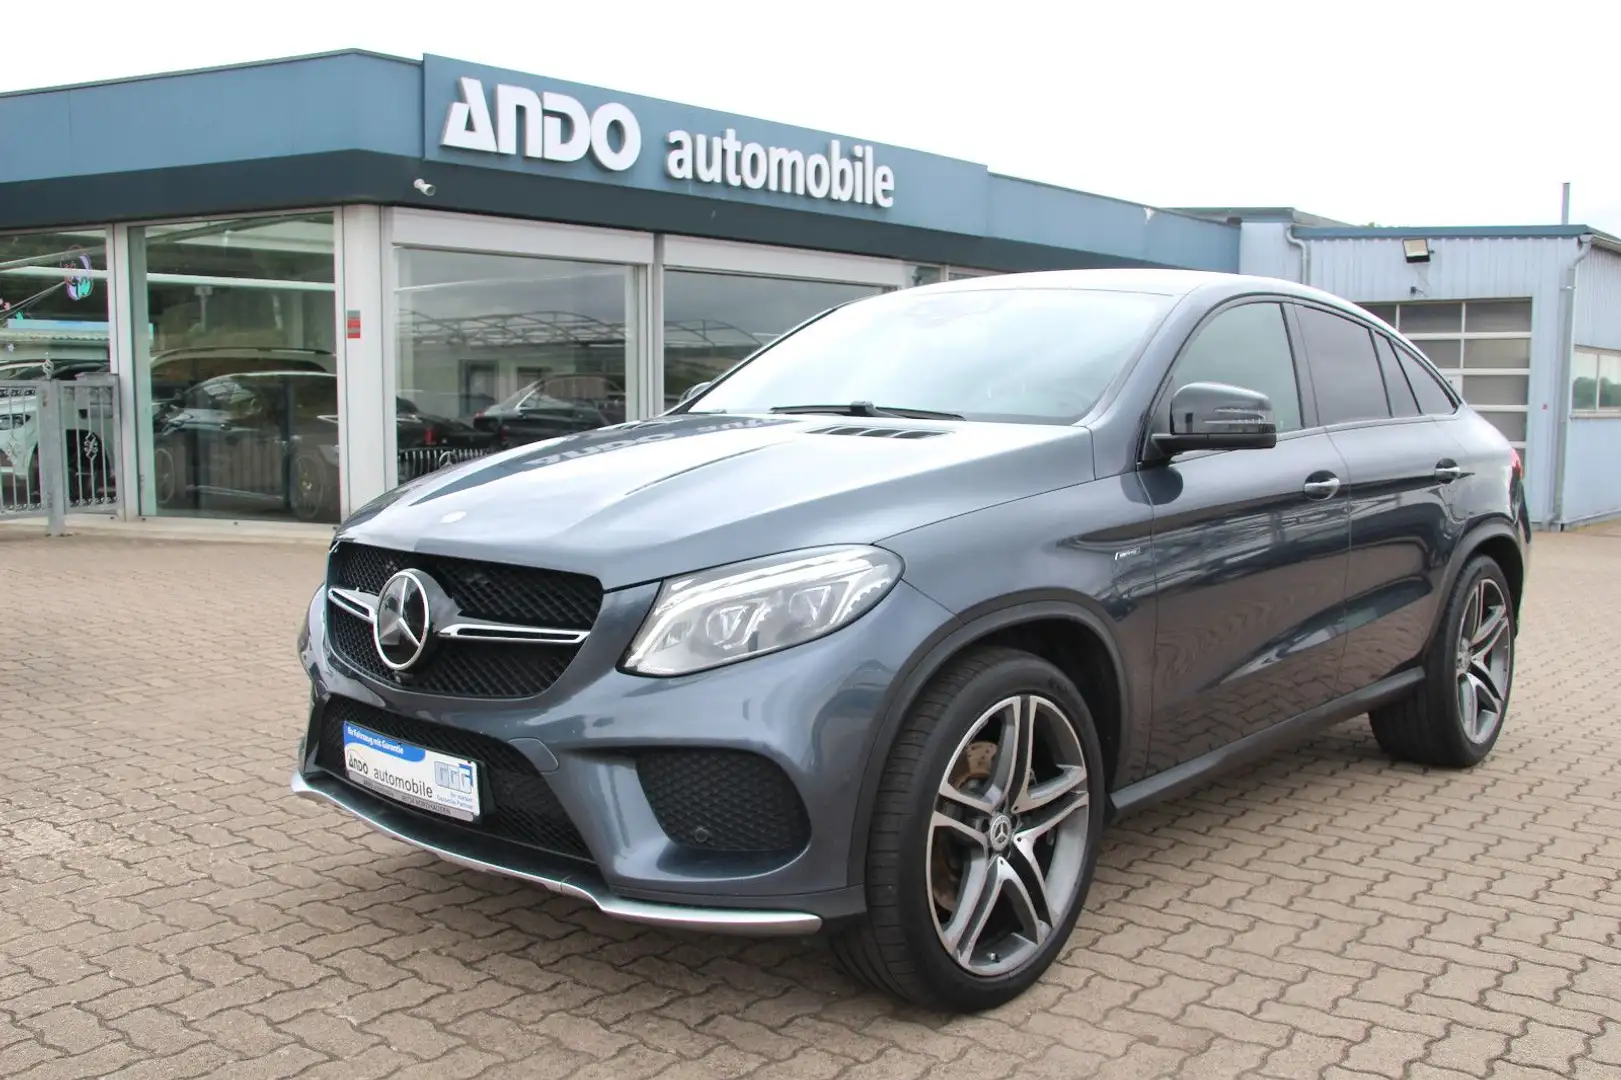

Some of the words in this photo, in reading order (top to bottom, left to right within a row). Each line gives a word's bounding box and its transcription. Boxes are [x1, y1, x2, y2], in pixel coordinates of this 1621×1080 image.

[439, 77, 641, 172] ANDO
[665, 127, 896, 209] automobile
[348, 754, 369, 775] ANDO
[373, 767, 433, 798] automobile
